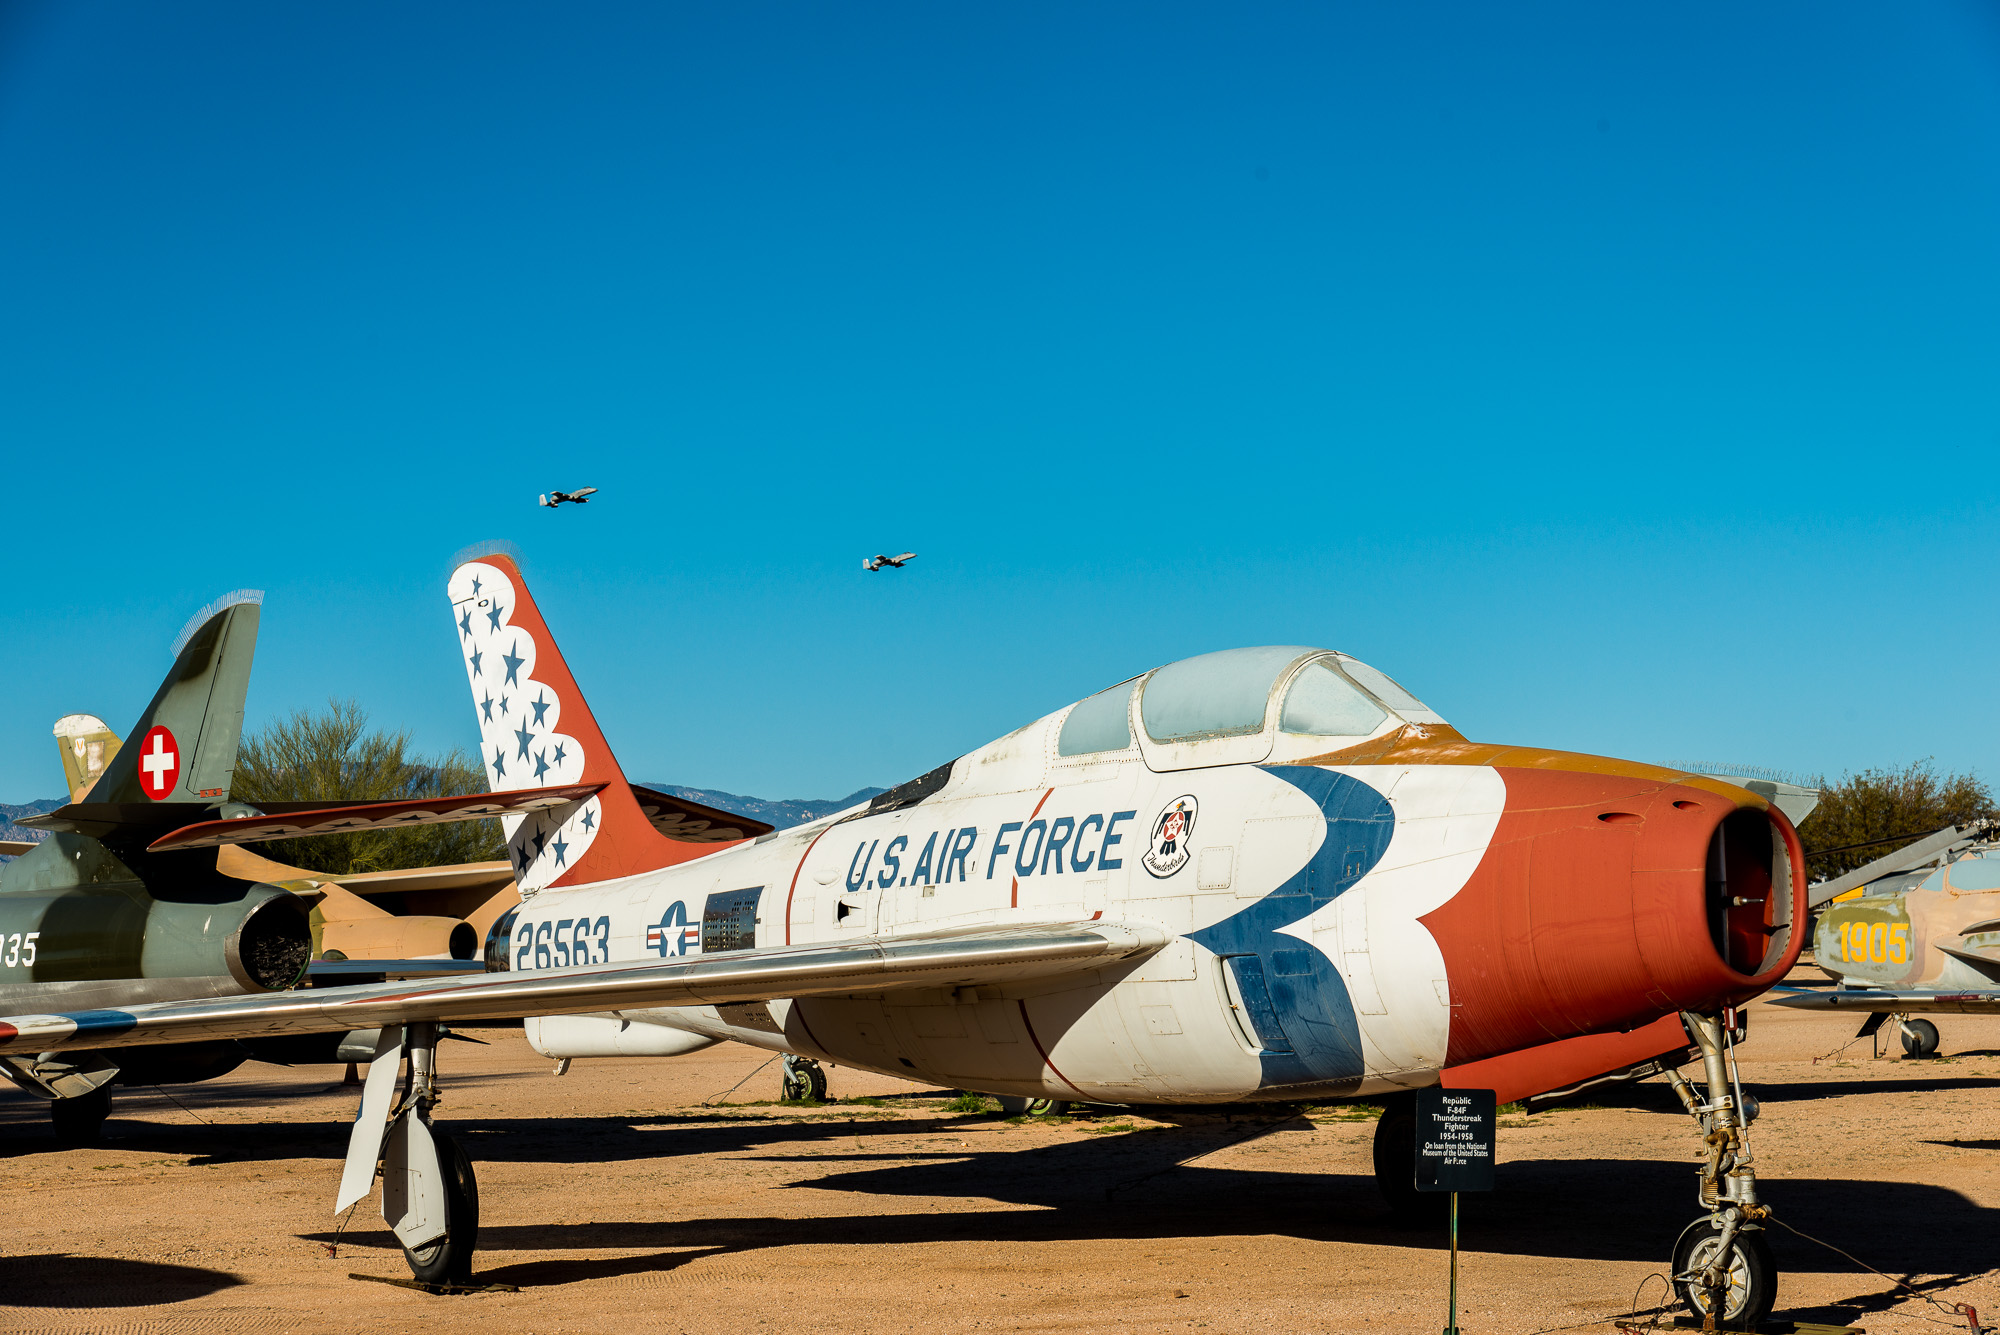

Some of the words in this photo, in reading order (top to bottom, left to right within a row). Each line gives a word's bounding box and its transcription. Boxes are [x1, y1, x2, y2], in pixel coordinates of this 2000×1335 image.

[986, 810, 1137, 880] FORCE
[1147, 852, 1184, 872] Thunderbirds
[517, 916, 610, 970] 26563
[1839, 921, 1909, 964] 1905
[1442, 1096, 1472, 1106] Republic
[1447, 1106, 1467, 1114] F-84F
[1432, 1113, 1482, 1122] Thunderstreak
[1444, 1122, 1470, 1132] Fighter
[1439, 1132, 1474, 1140] 1954-1958
[1457, 1142, 1466, 1150] the
[1466, 1142, 1487, 1150] National
[1422, 1149, 1442, 1157] Museum
[1443, 1149, 1449, 1157] of
[1457, 1149, 1473, 1157] United
[1444, 1157, 1453, 1165] Air
